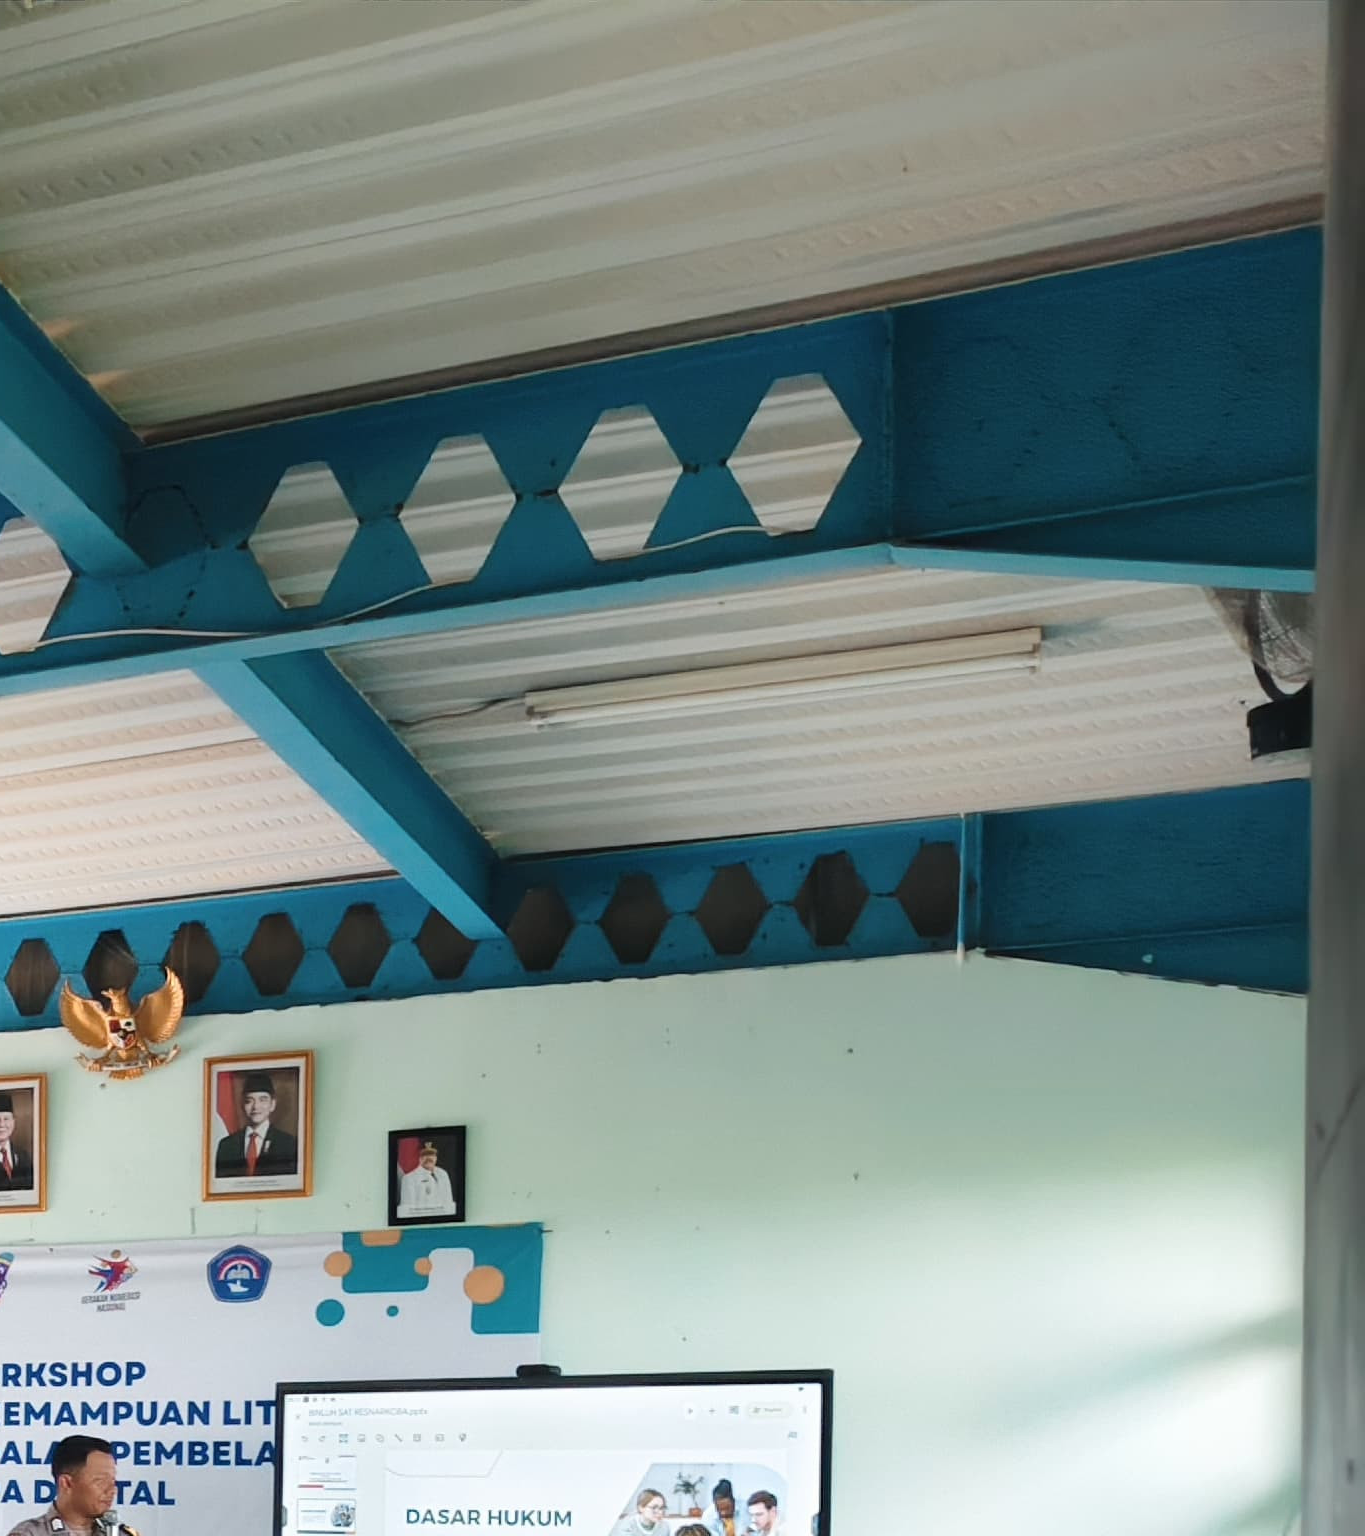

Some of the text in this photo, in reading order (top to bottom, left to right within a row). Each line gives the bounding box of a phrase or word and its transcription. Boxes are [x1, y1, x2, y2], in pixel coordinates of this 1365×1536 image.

[222, 1400, 276, 1426] LIT
[110, 1440, 275, 1467] PEMBELA
[34, 1479, 176, 1506] DTAL
[406, 1508, 572, 1527] DASAR HUKUM
